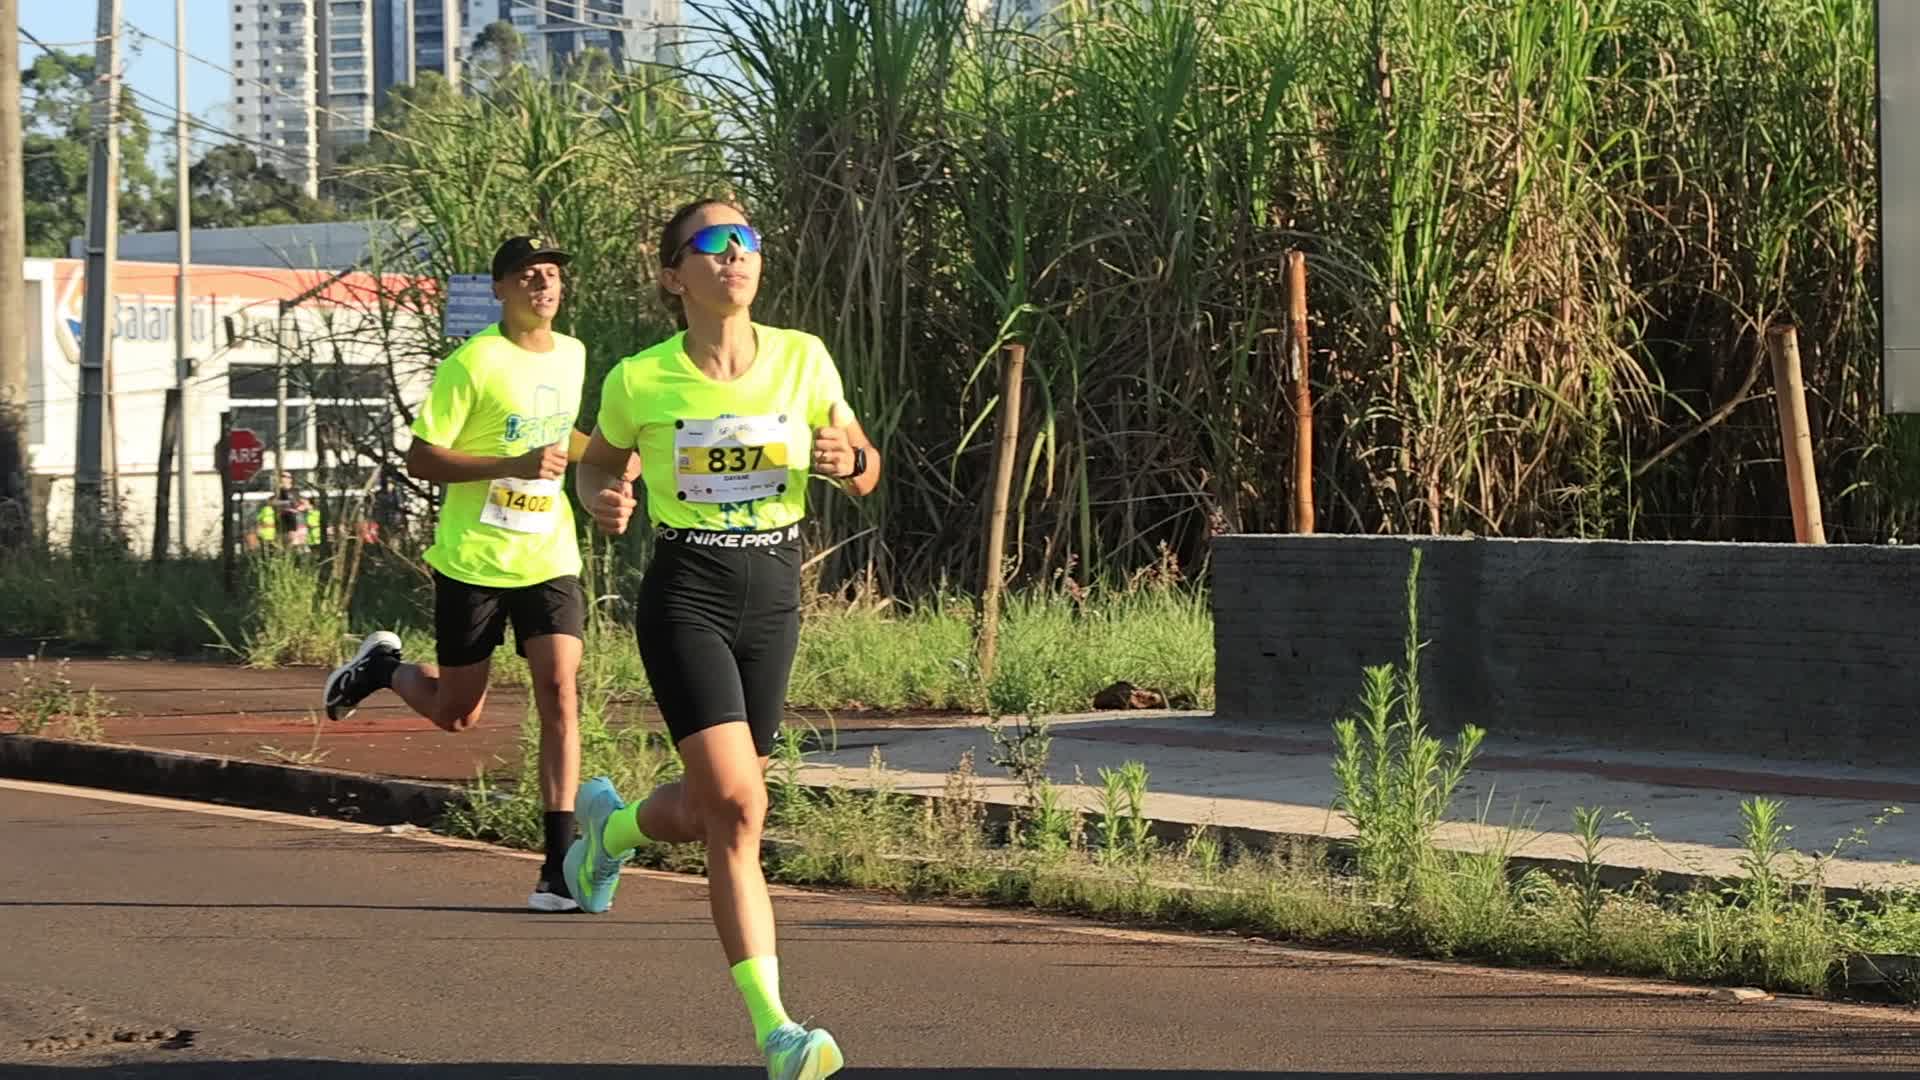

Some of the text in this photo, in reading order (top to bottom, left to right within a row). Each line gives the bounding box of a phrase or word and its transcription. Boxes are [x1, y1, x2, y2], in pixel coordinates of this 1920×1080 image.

[228, 447, 261, 463] ARE
[708, 446, 765, 473] 837
[504, 491, 548, 512] 1402
[656, 526, 679, 541] RO
